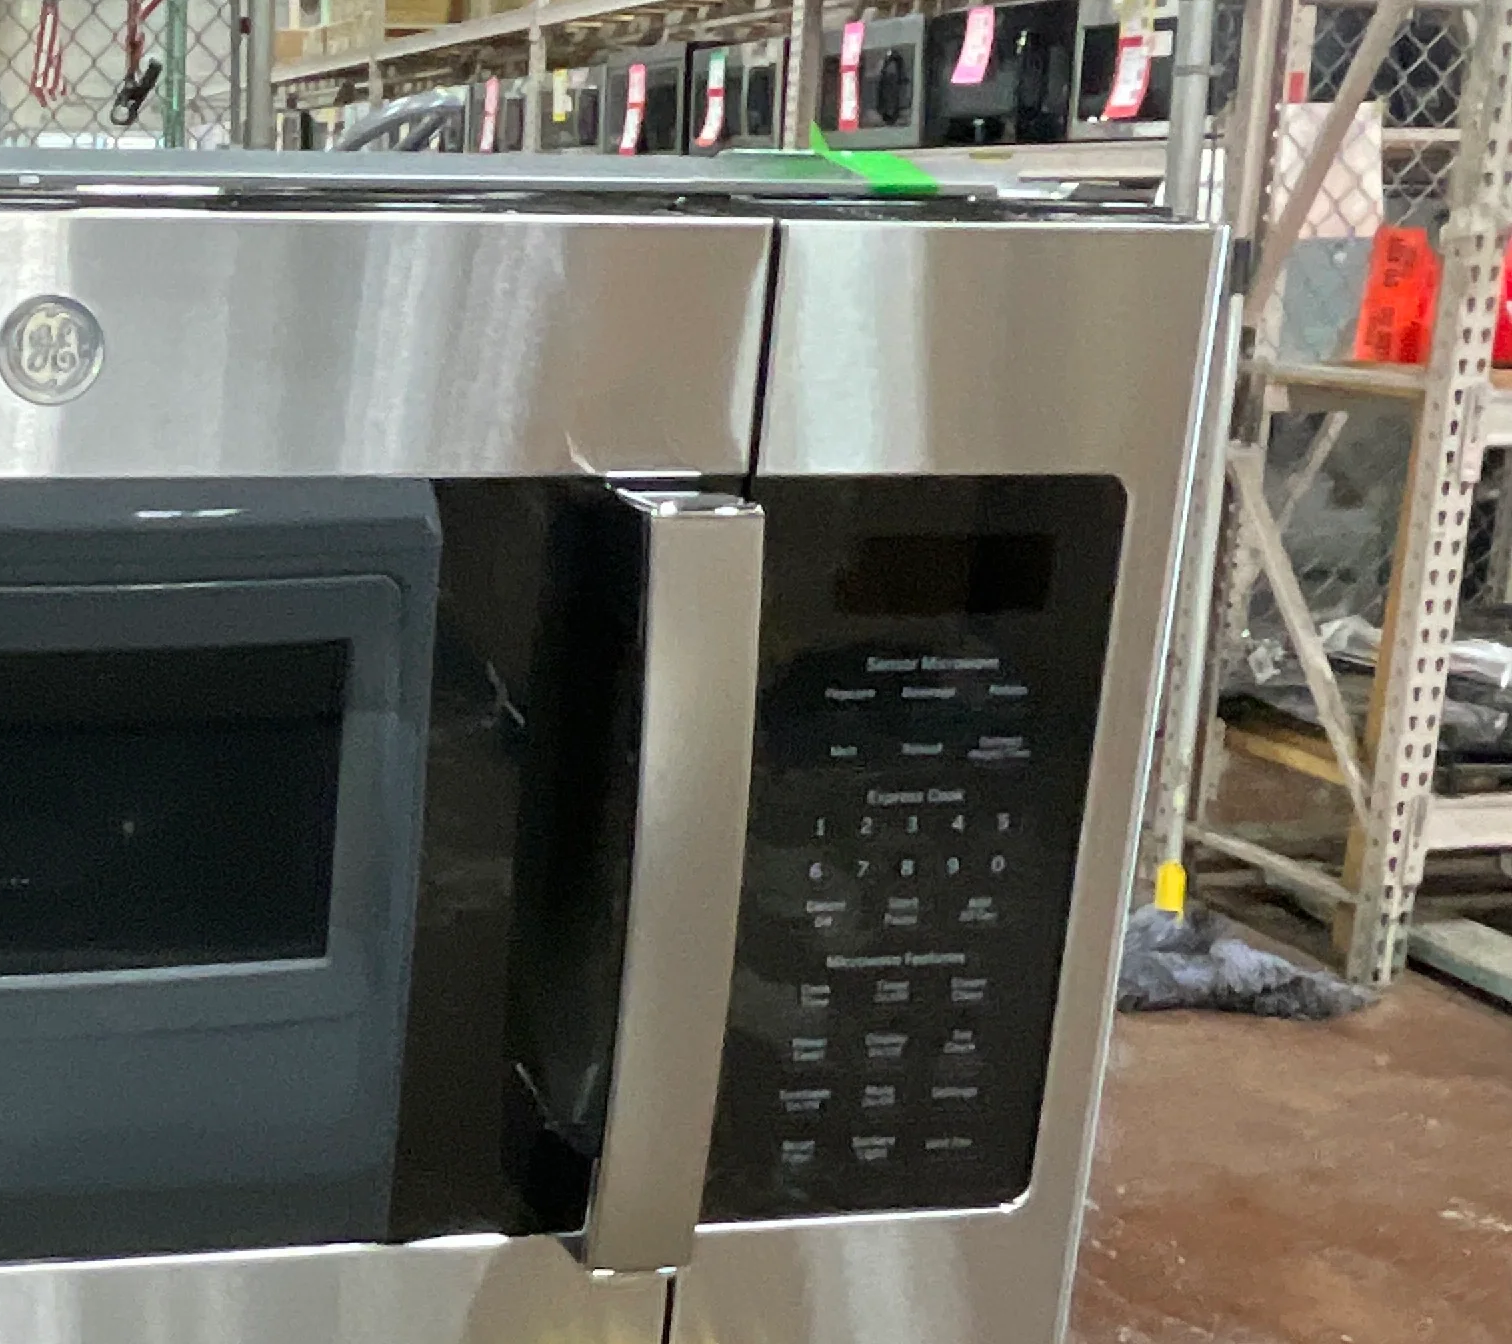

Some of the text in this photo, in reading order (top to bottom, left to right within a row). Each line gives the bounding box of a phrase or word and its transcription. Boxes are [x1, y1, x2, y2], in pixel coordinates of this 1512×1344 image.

[816, 812, 1010, 836] 1 2 3 4 5
[809, 855, 1005, 879] 6 7 8 9 0
